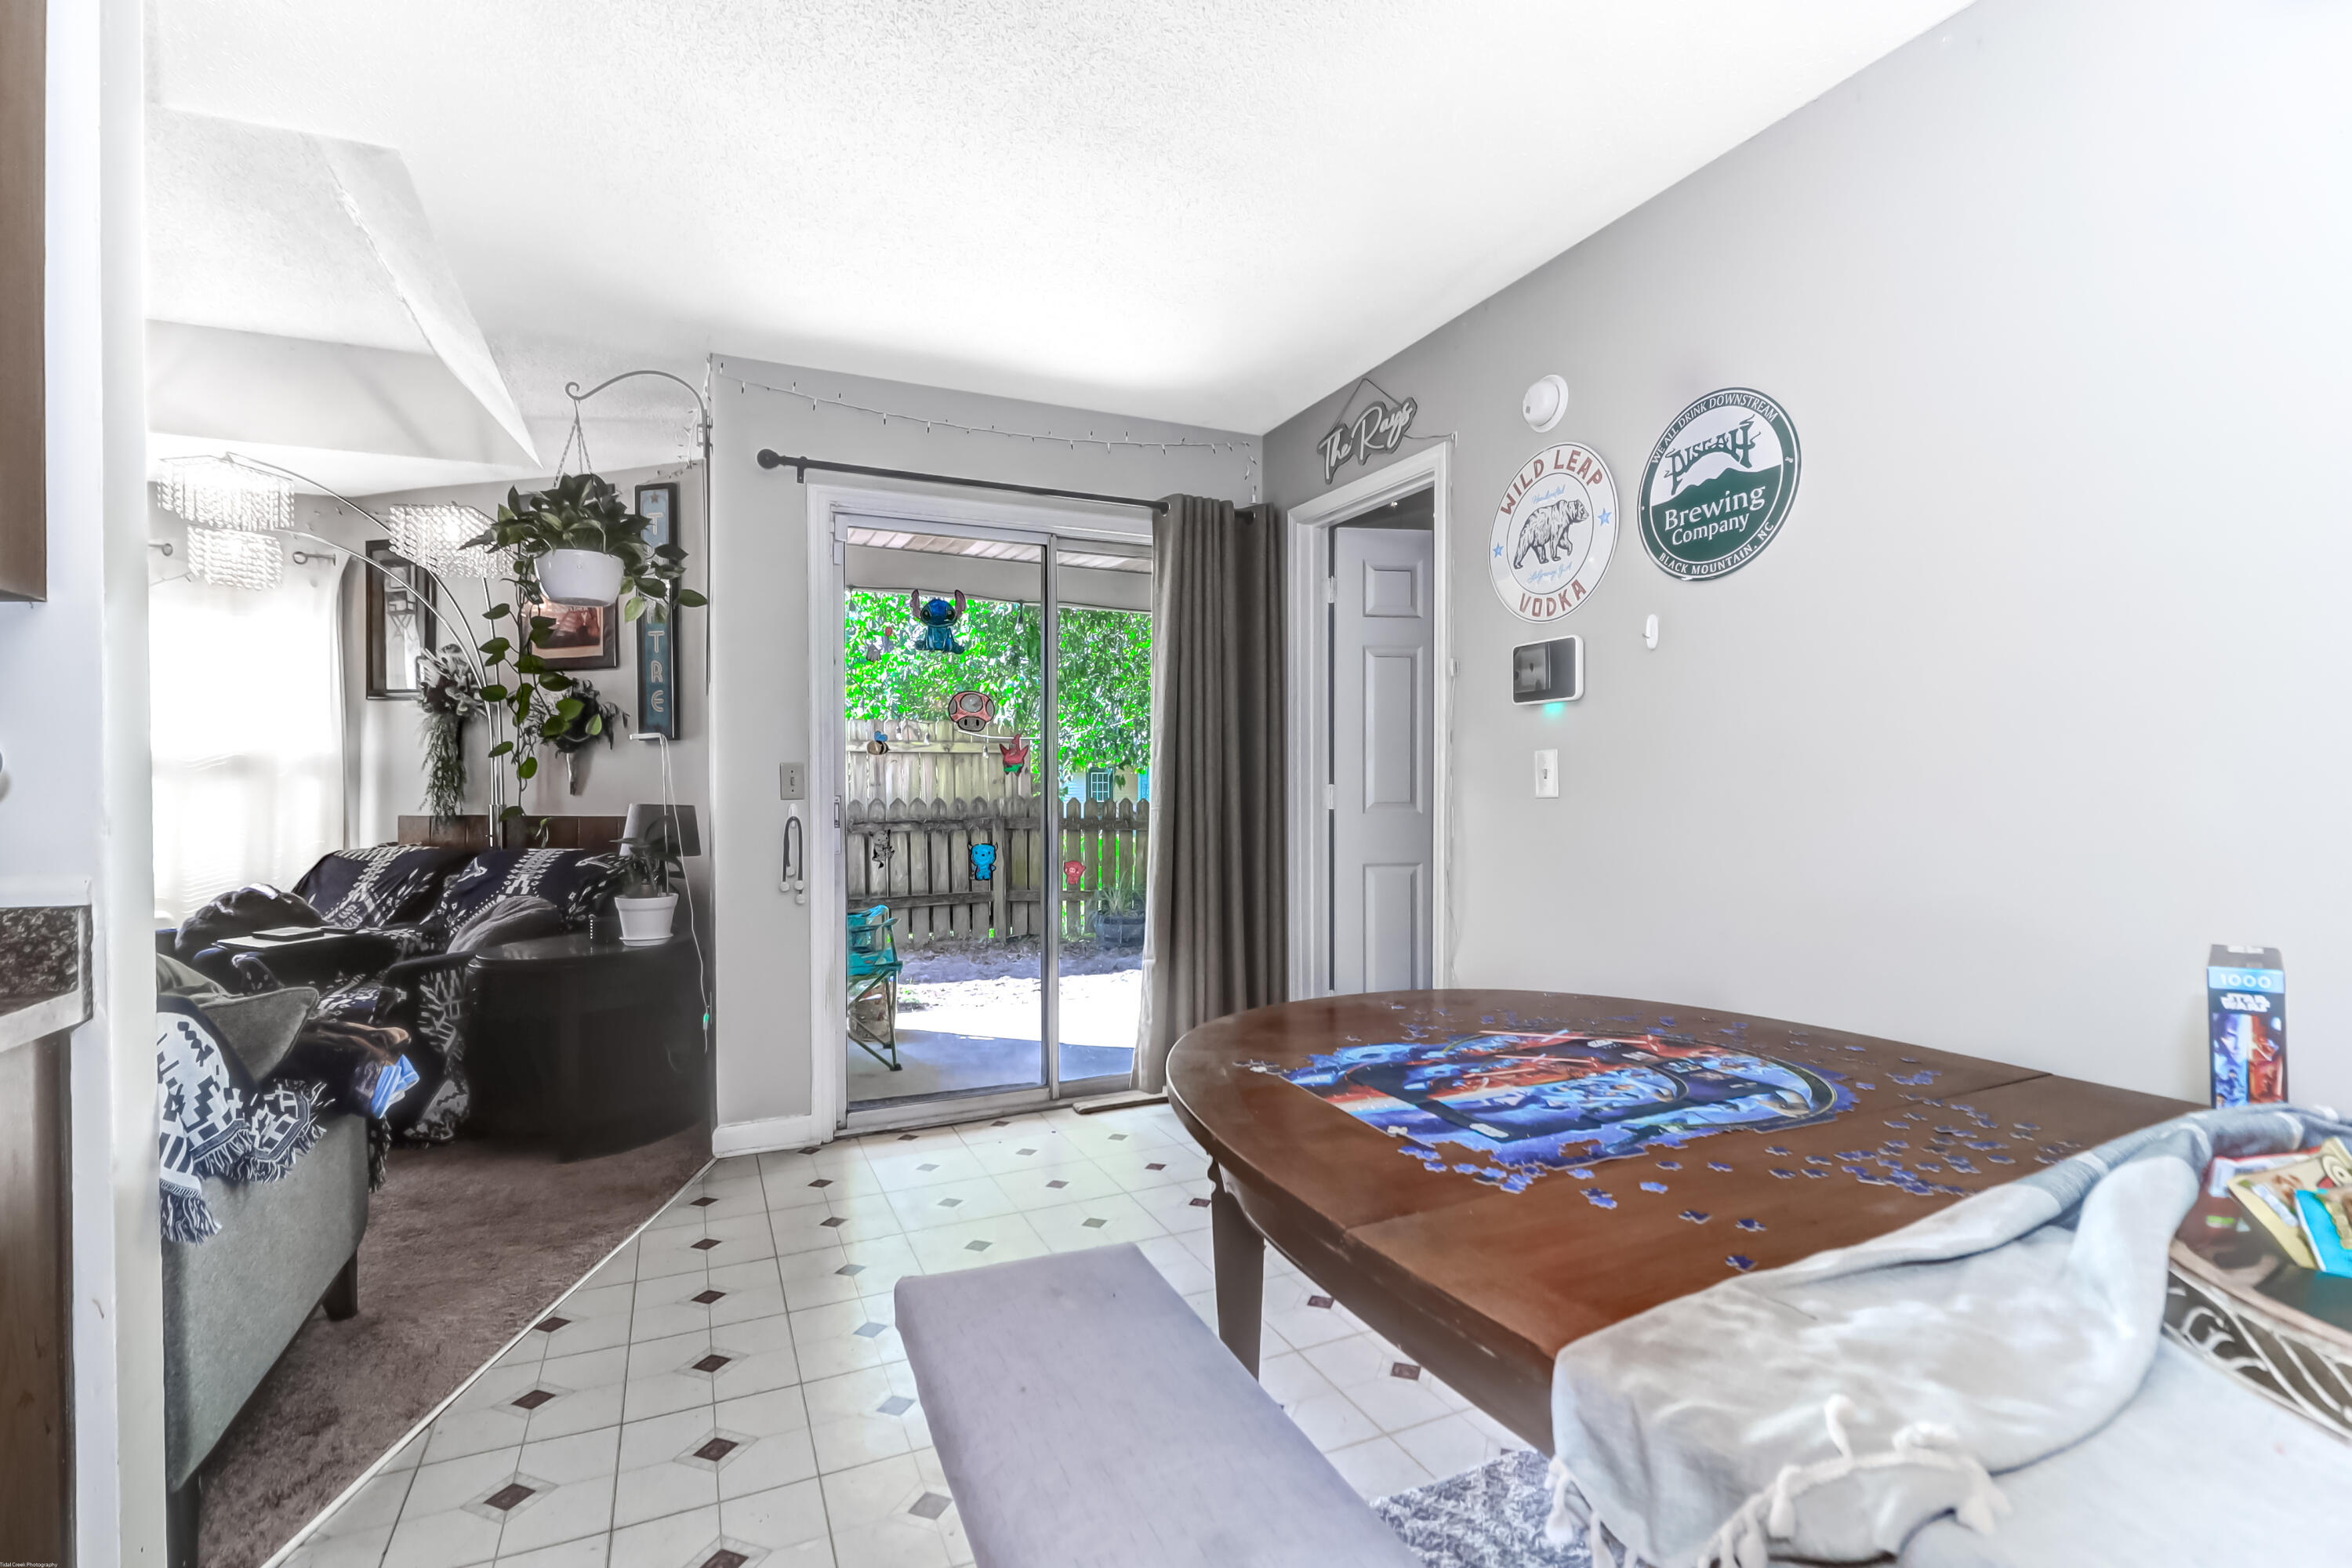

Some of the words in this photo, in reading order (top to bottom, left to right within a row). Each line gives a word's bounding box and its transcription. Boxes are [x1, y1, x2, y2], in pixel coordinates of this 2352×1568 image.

[1652, 445, 1665, 463] WE
[1664, 427, 1679, 446] ALL
[1678, 401, 1707, 428] DRINK
[1709, 393, 1779, 423] DOWNSTREAM
[1319, 429, 1352, 480] The
[1501, 459, 1544, 515] WILD
[1553, 449, 1602, 486] LEAP
[1664, 485, 1766, 532] Brewing
[1672, 513, 1750, 546] Company
[1659, 553, 1688, 573] BLACK
[1757, 521, 1774, 542] NC
[1519, 579, 1587, 617] VODKA
[2220, 974, 2272, 989] 1000
